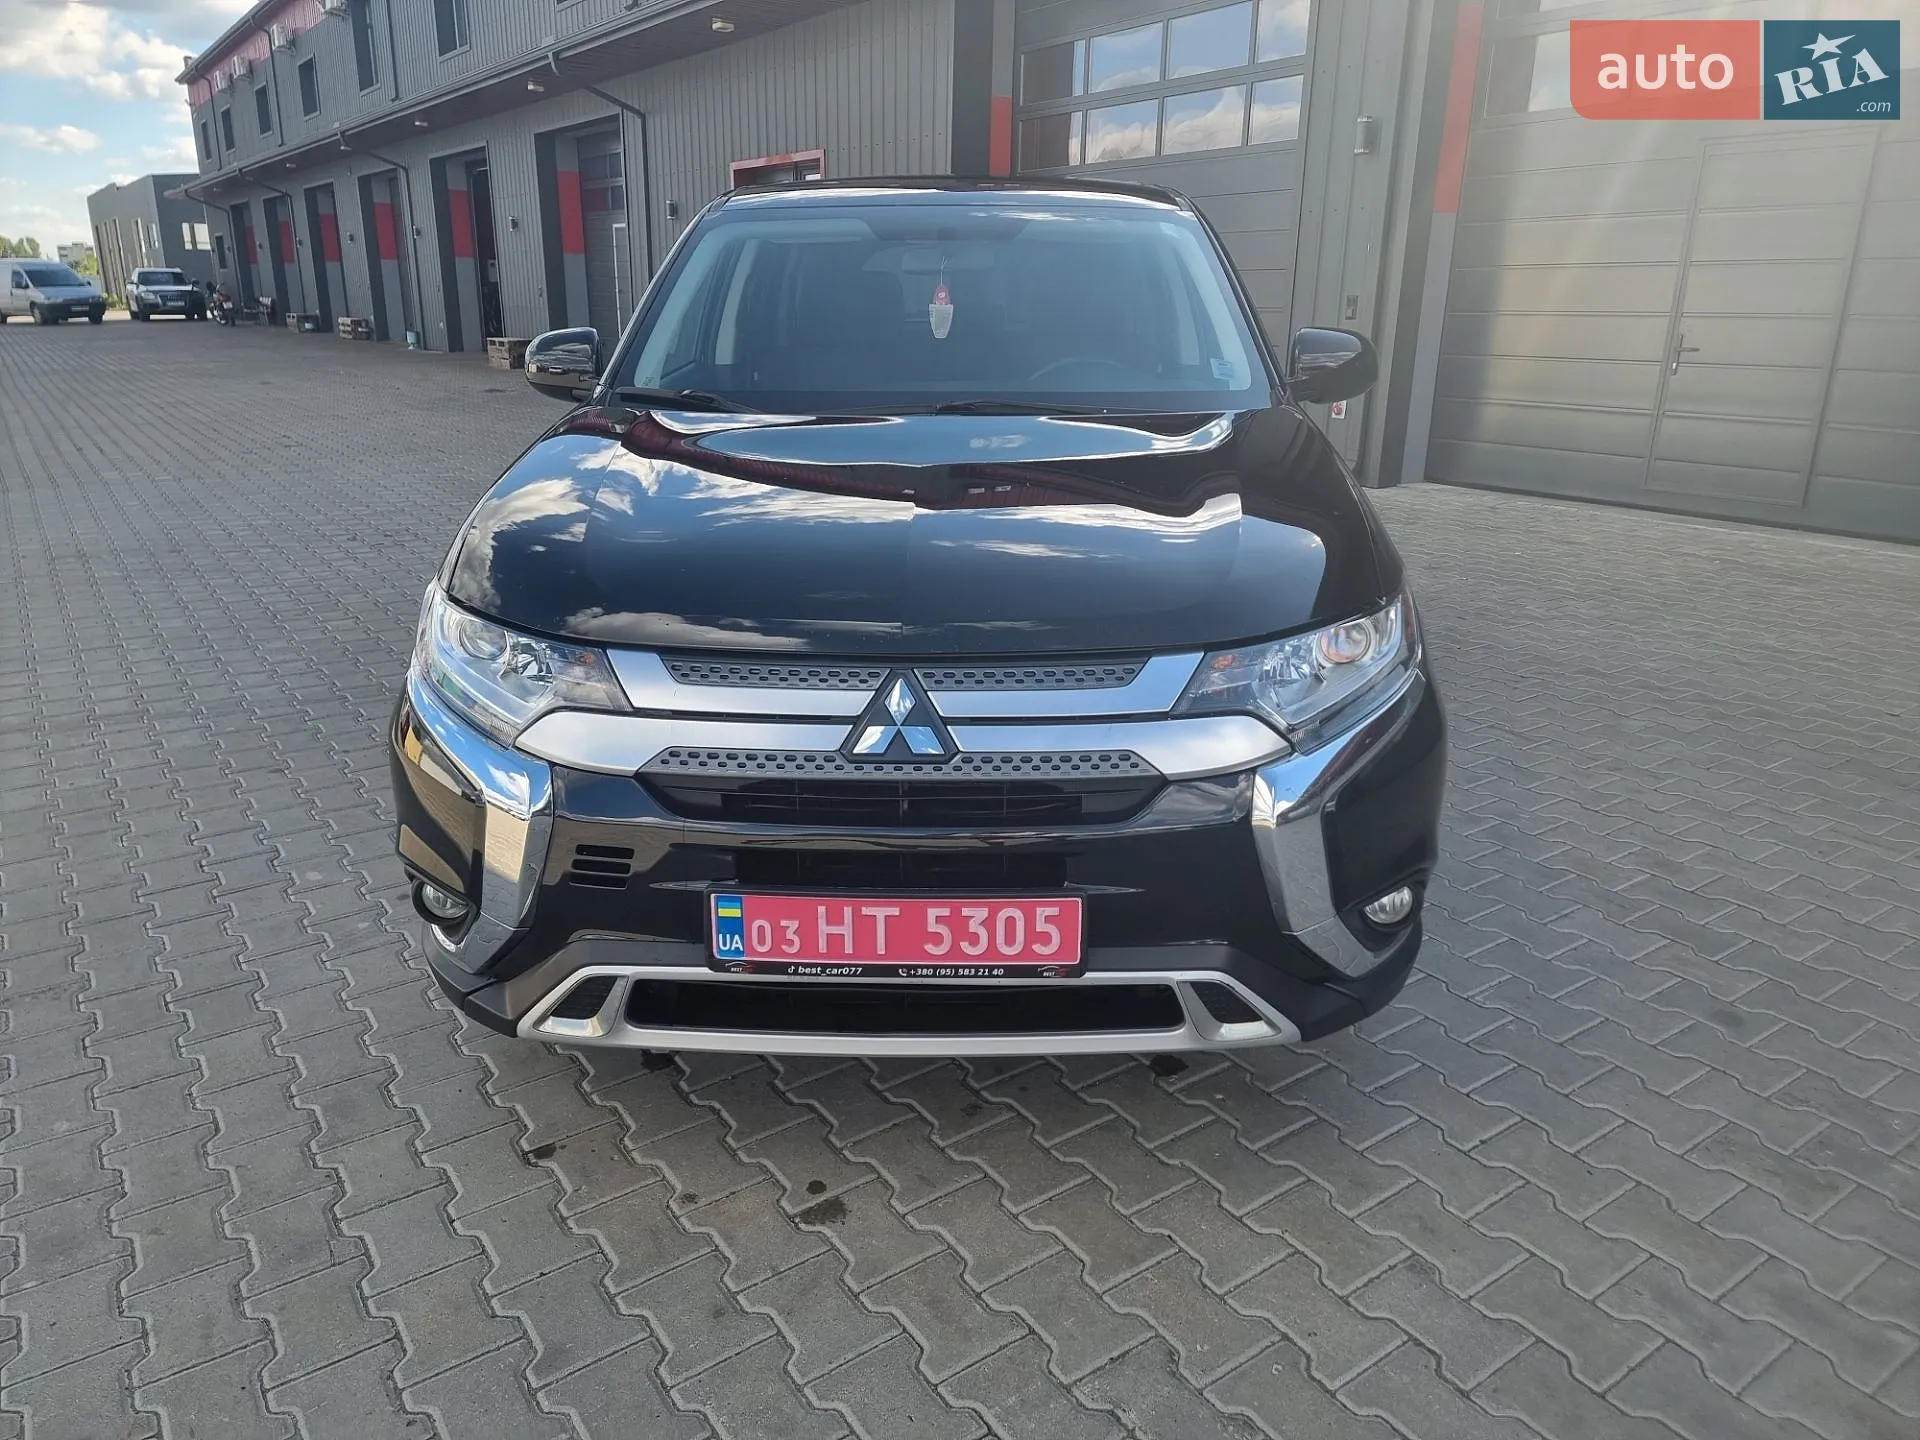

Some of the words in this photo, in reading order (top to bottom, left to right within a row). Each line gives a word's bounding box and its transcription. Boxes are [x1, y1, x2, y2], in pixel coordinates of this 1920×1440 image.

[751, 919, 801, 954] 03
[817, 905, 900, 955] HT
[924, 907, 1061, 956] 5305
[718, 933, 743, 951] UA
[798, 965, 863, 976] best_car077
[909, 968, 934, 976] +380
[936, 968, 955, 976] (95)
[977, 968, 989, 976] 21
[991, 968, 1004, 976] 40
